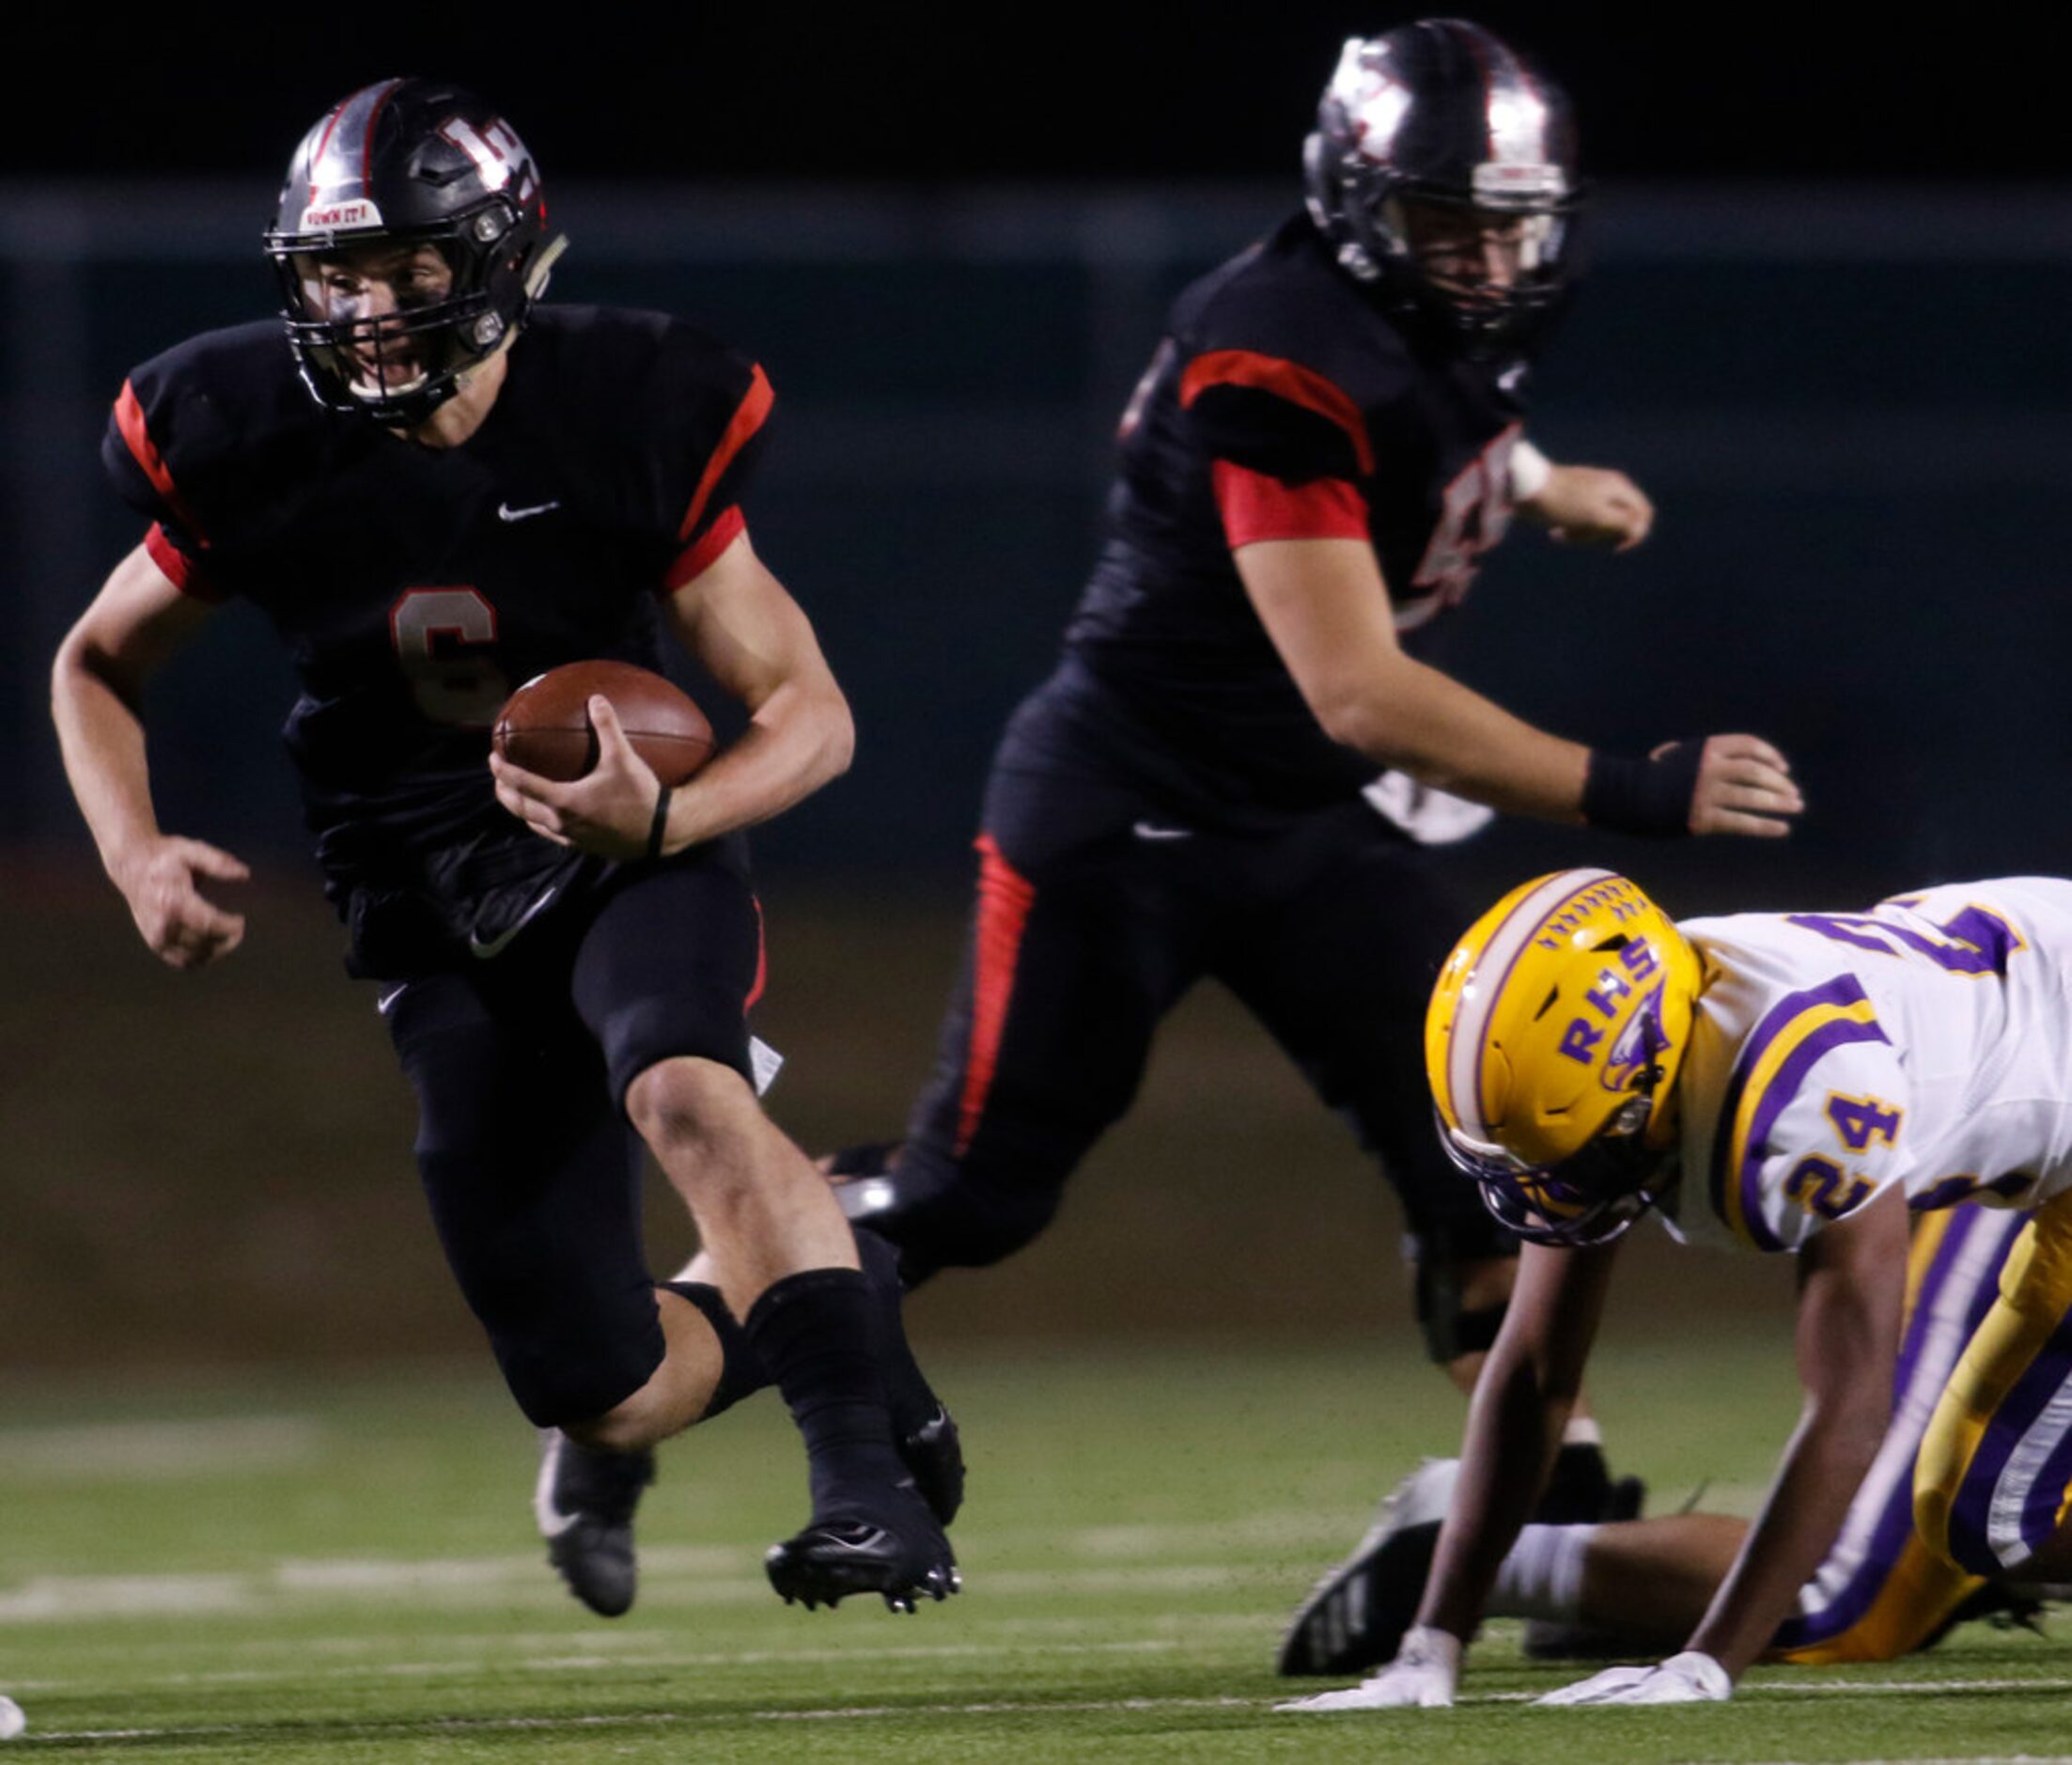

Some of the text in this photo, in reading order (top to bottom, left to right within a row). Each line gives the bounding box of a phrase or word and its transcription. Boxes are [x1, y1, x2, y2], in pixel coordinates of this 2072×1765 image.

[388, 585, 512, 736] 6
[1559, 936, 1659, 1065] RHS
[1782, 1088, 1905, 1222] 24
